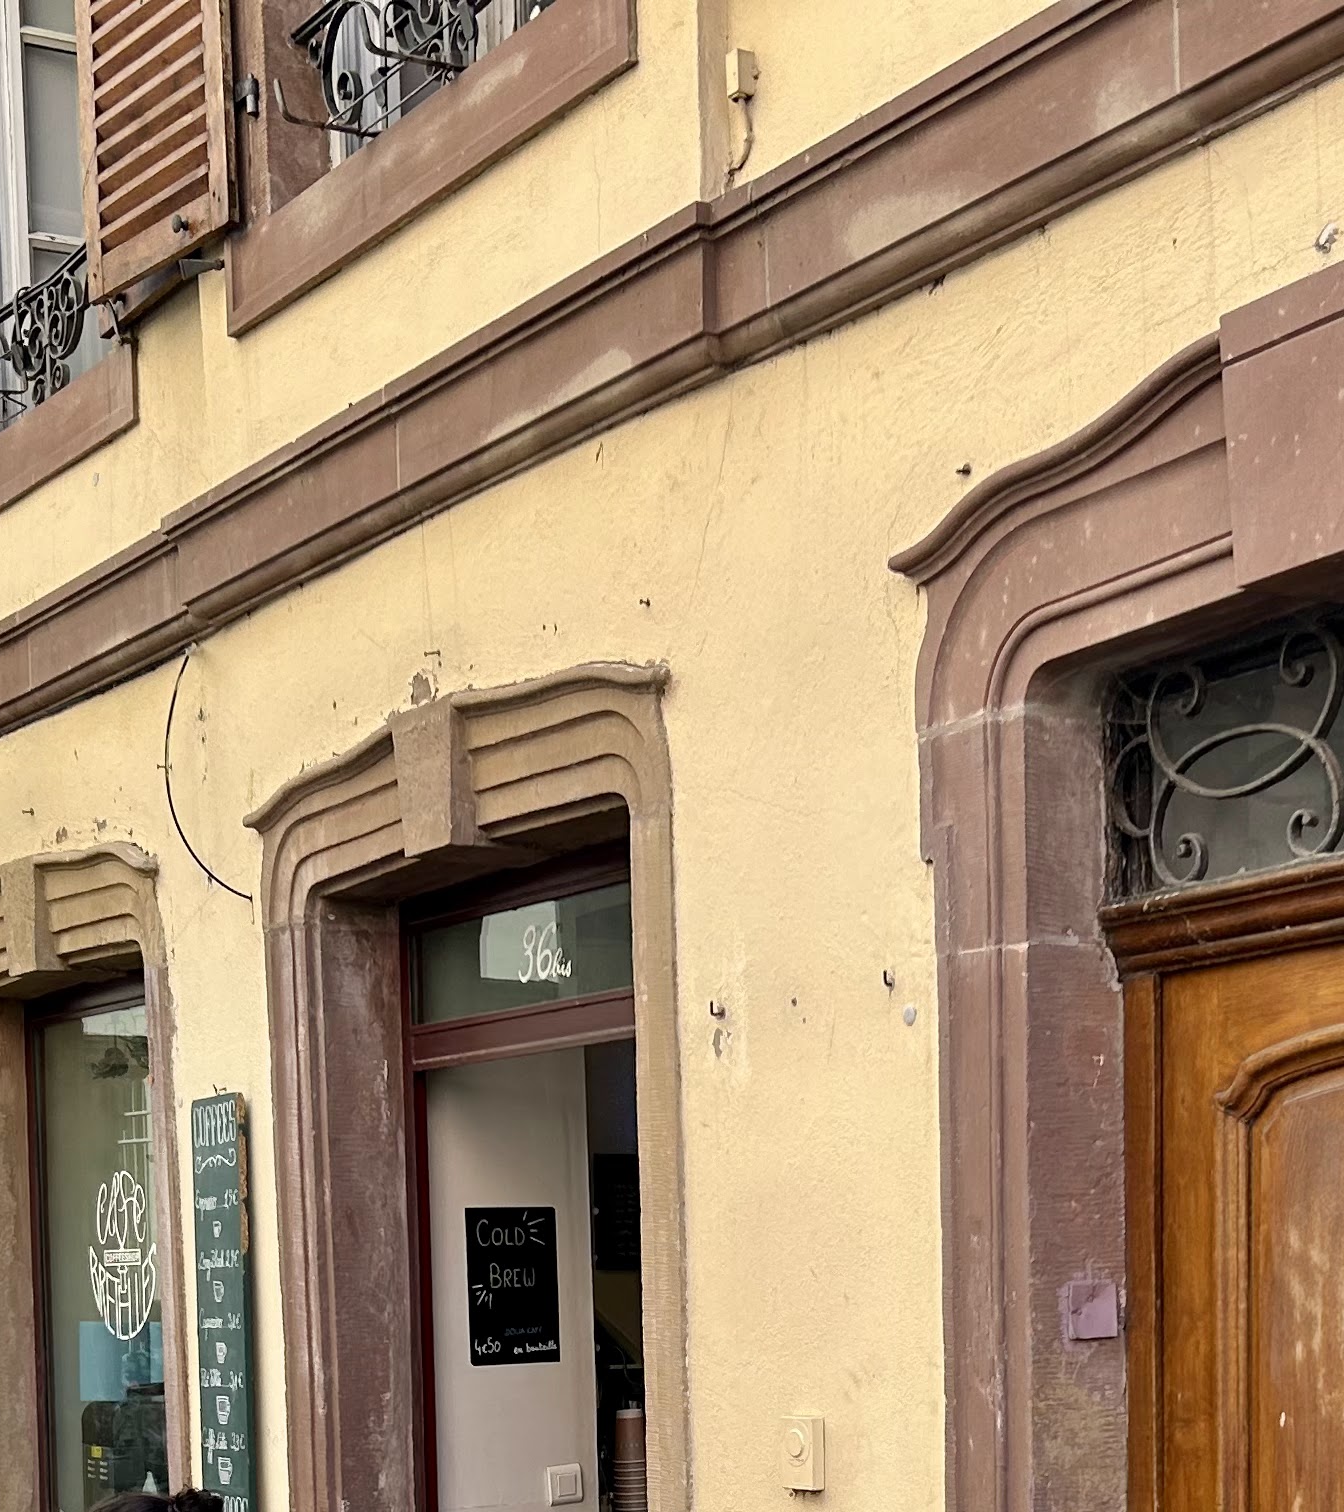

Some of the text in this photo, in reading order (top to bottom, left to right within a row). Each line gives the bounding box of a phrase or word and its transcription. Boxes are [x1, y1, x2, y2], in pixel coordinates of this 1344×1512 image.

[518, 921, 557, 984] 36
[193, 1100, 236, 1148] COFFEES
[476, 1219, 525, 1247] COLD
[489, 1263, 535, 1289] BREW
